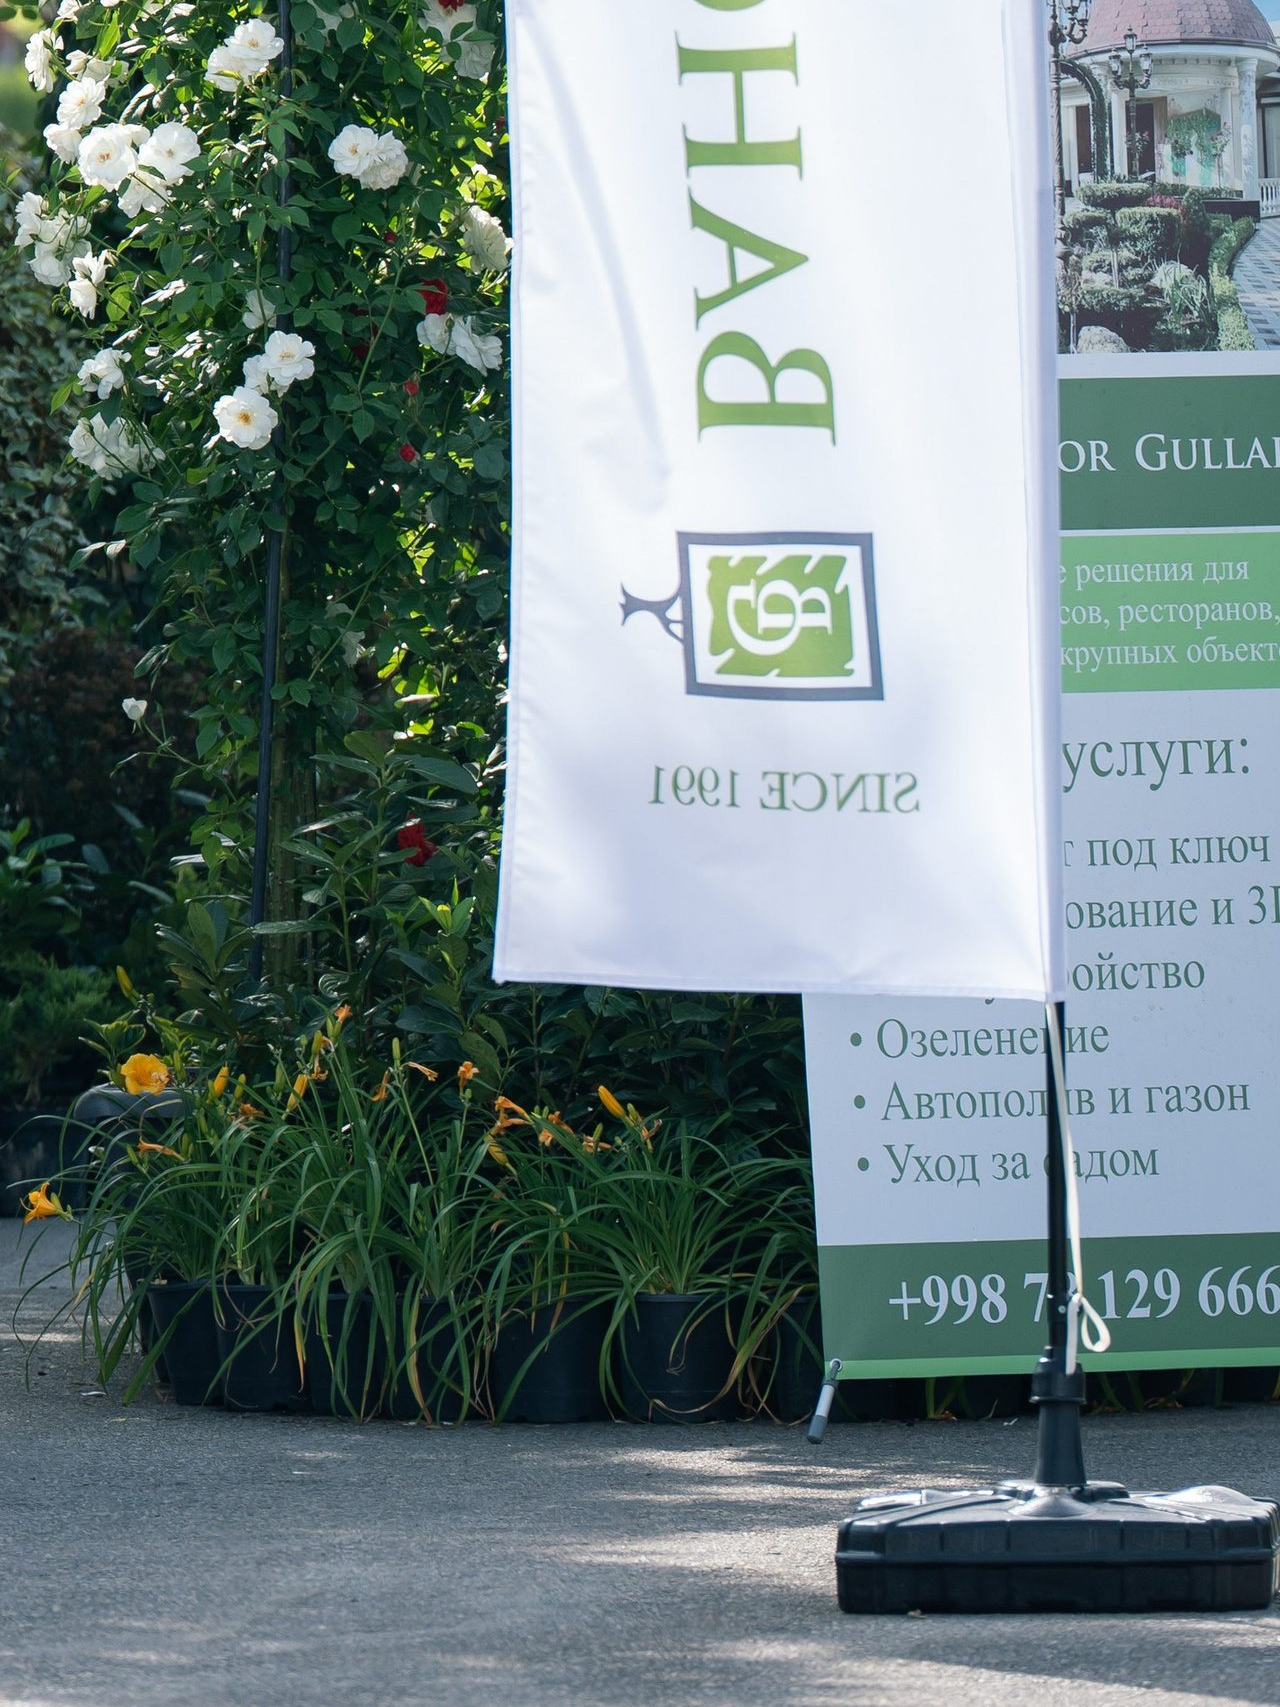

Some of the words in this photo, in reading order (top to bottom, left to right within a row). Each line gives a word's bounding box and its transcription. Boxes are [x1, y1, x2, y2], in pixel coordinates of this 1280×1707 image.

[1075, 562, 1195, 591] решения
[1202, 561, 1250, 585] для
[1118, 601, 1280, 632] ресторанов,
[1061, 644, 1179, 673] крупных
[1186, 635, 1280, 664] объект
[1061, 737, 1250, 794] услуги:
[1086, 838, 1158, 872] под
[1169, 835, 1271, 865] ключ
[1210, 898, 1235, 925] и
[1108, 1086, 1133, 1116] и
[1144, 1083, 1251, 1116] газон
[882, 1143, 981, 1188] Уход
[991, 1151, 1031, 1182] за
[888, 1272, 1008, 1326] +998
[1097, 1267, 1182, 1320] 129
[1198, 1265, 1280, 1317] 666
